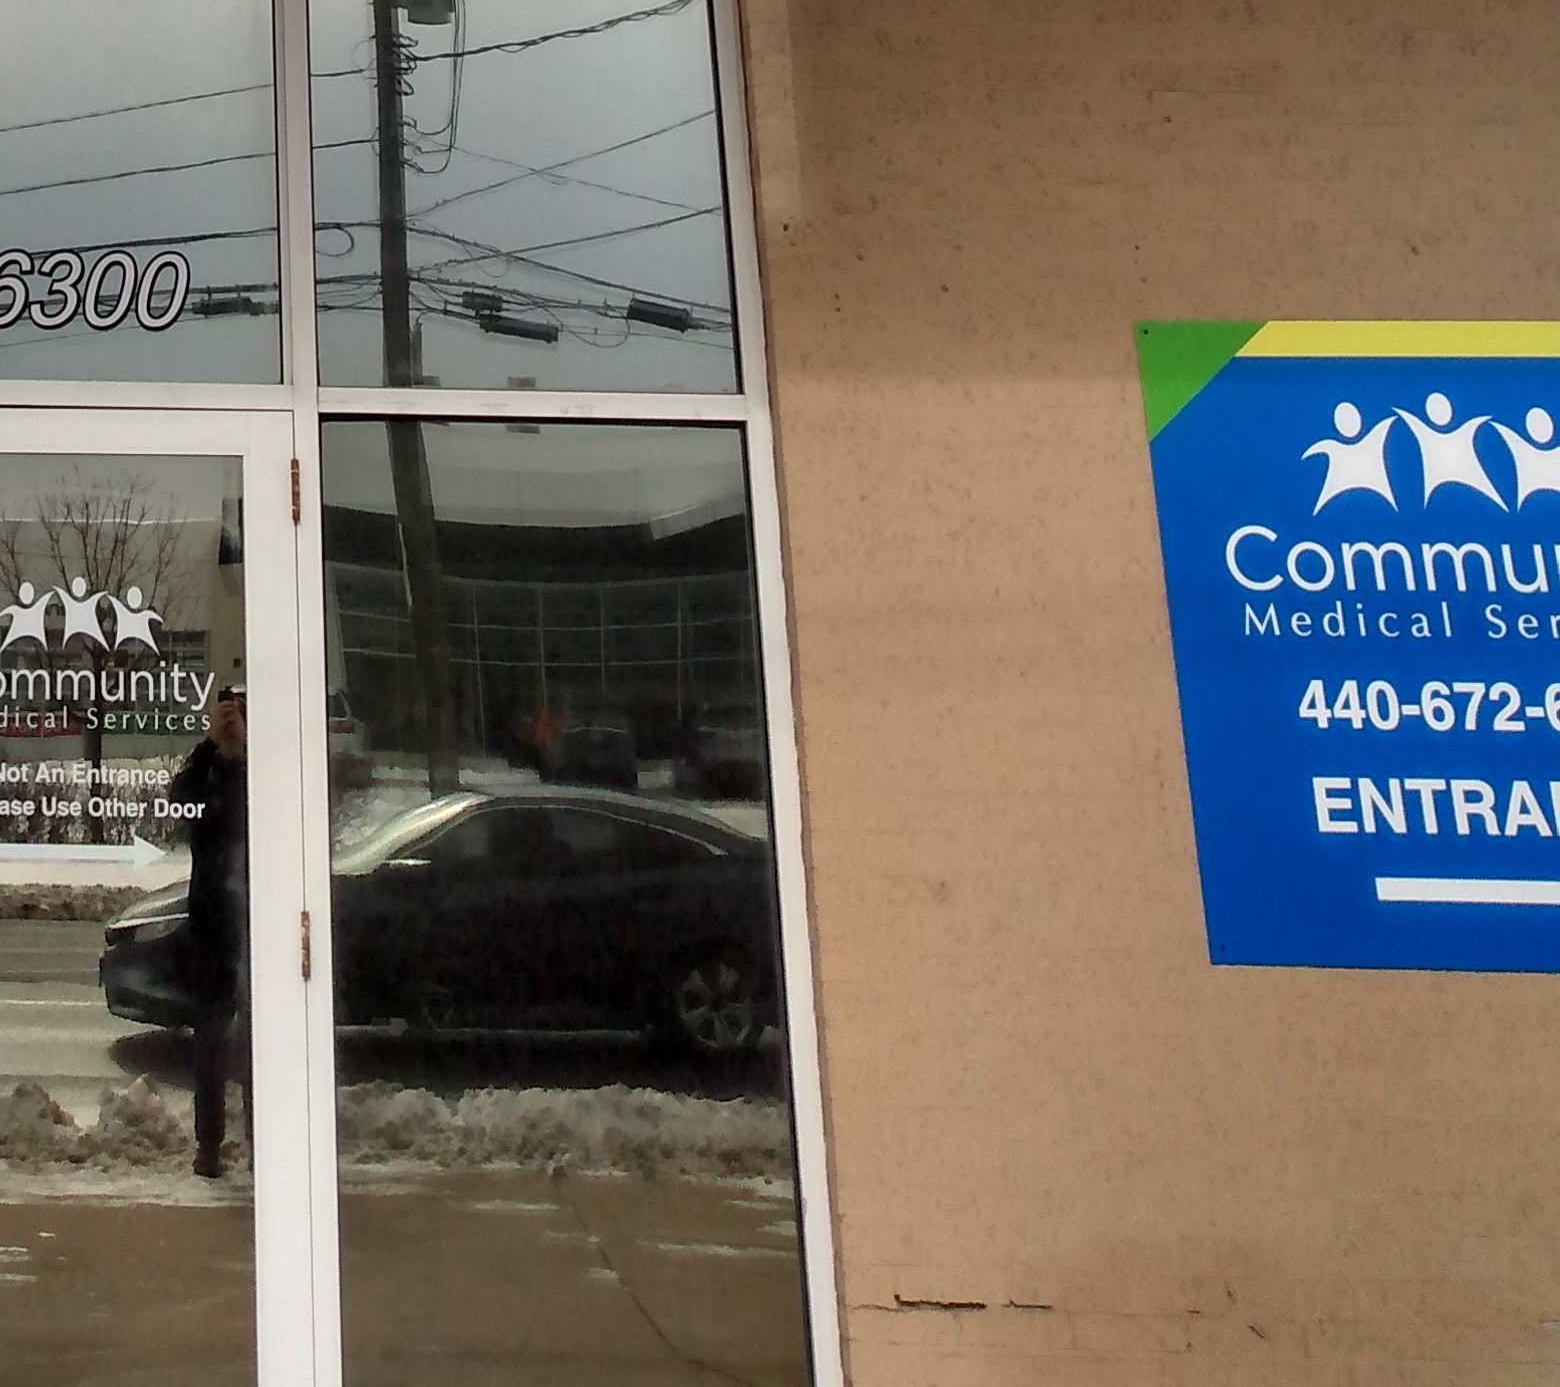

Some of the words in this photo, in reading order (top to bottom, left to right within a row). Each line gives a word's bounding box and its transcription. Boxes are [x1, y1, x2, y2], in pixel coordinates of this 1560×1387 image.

[1225, 525, 1560, 593] Commu
[1243, 600, 1453, 638] Medical
[86, 706, 211, 731] Services
[35, 762, 65, 783] An
[72, 763, 170, 785] Entrance
[41, 796, 82, 816] Use
[89, 797, 147, 818] Other
[154, 798, 206, 819] Door
[1312, 777, 1560, 837] ENTRA
